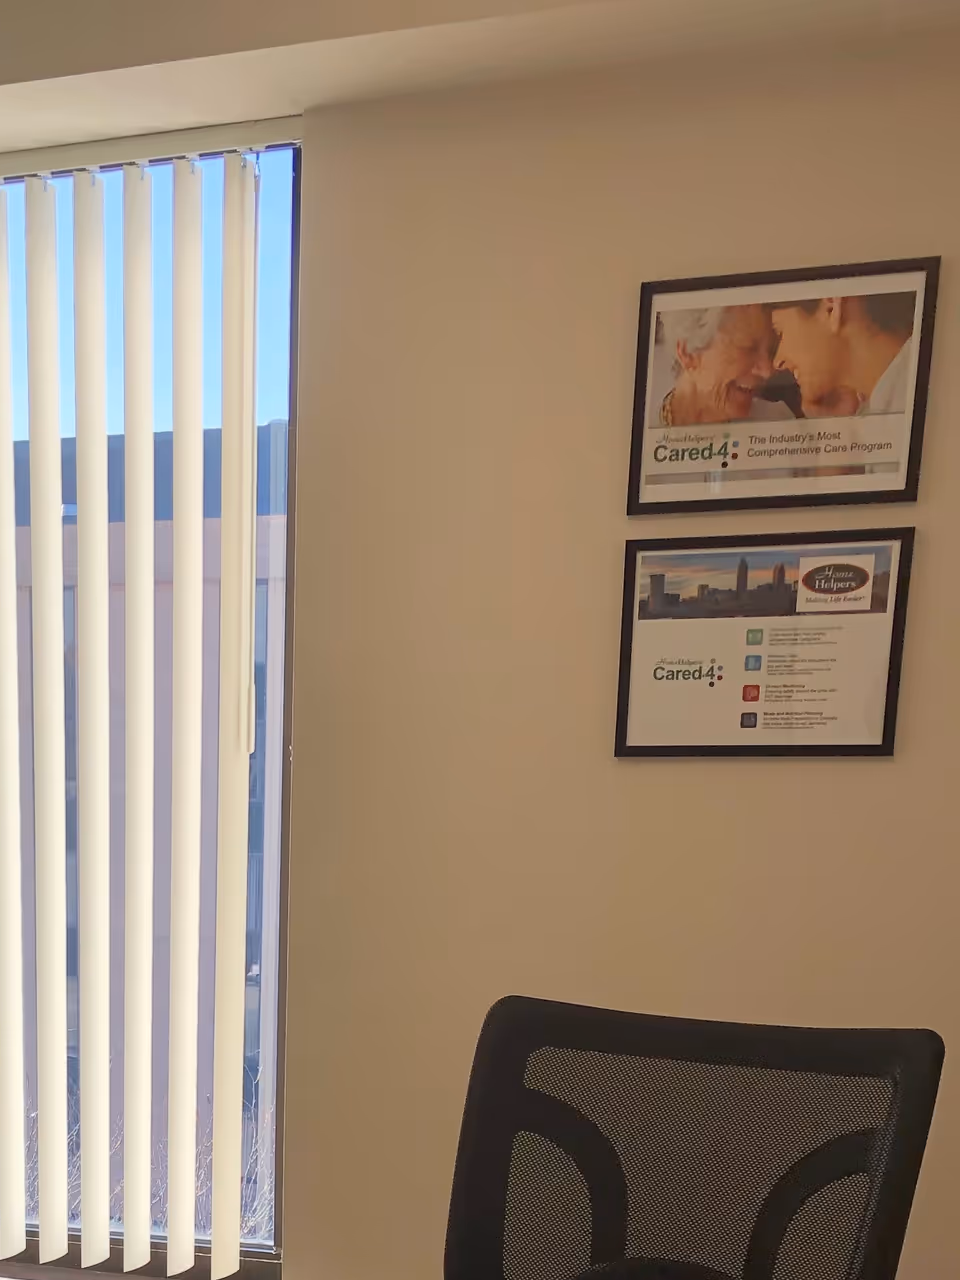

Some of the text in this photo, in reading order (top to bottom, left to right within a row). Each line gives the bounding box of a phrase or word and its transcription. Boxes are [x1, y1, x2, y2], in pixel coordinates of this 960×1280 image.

[748, 431, 841, 446] The Industry's Most
[747, 440, 893, 458] Comprehensive Care Program
